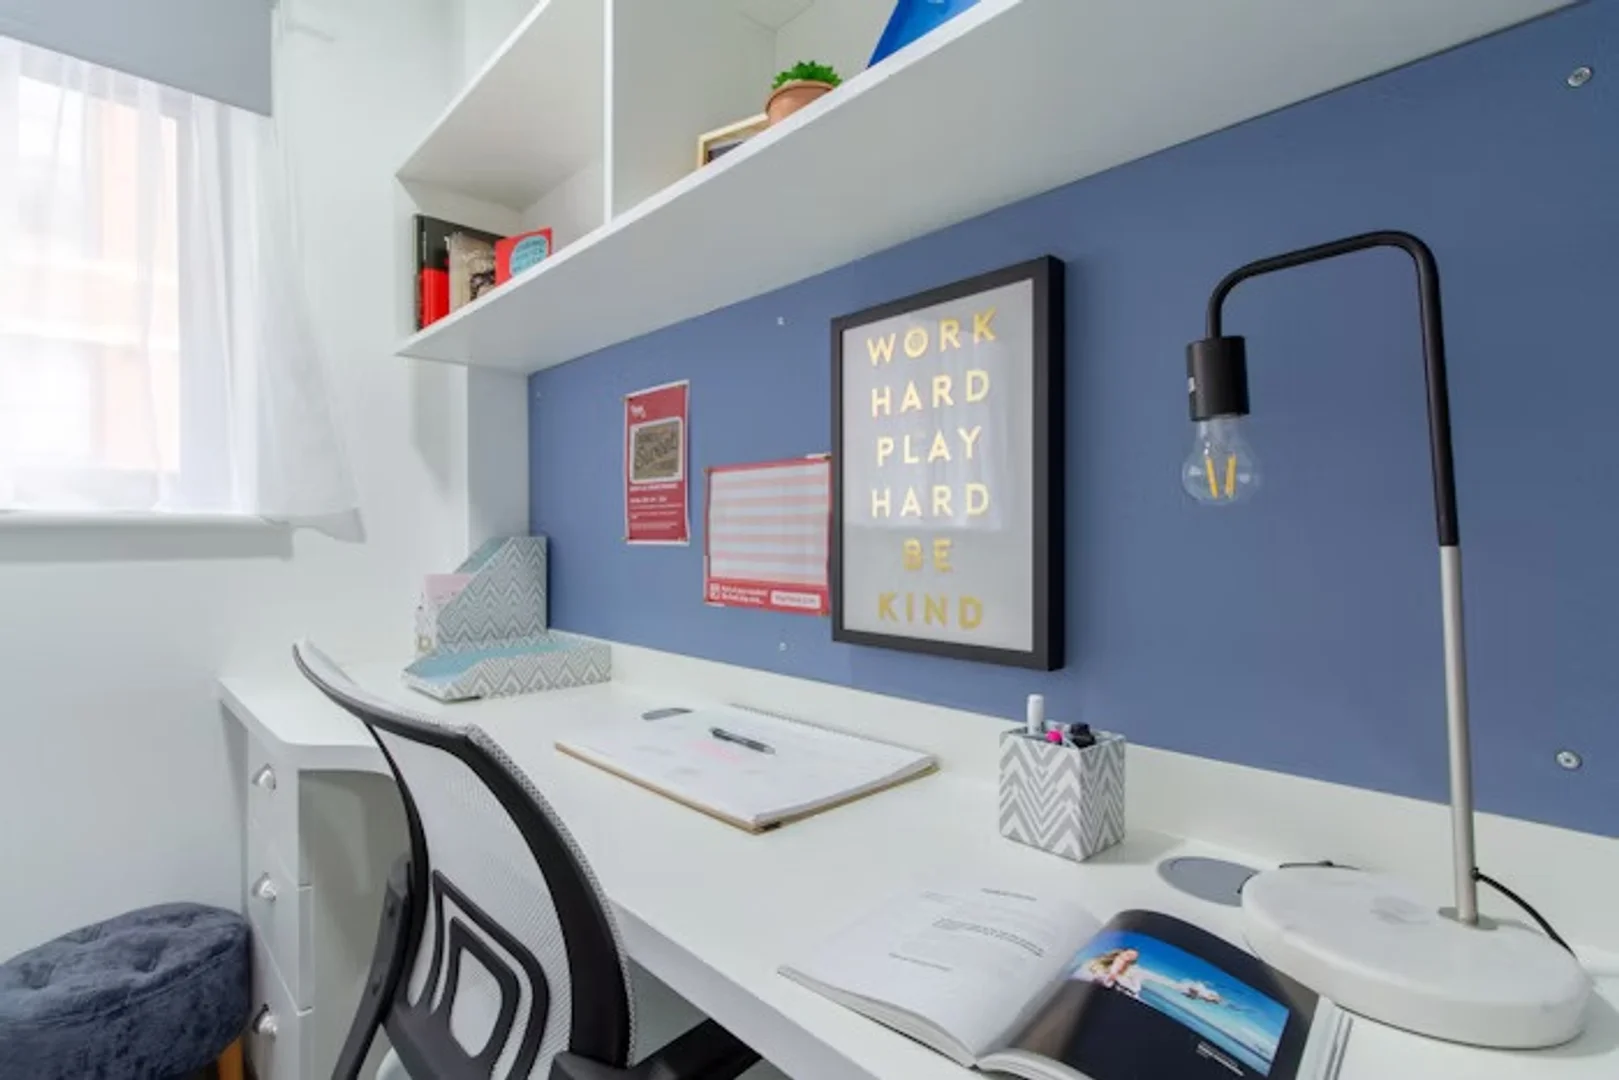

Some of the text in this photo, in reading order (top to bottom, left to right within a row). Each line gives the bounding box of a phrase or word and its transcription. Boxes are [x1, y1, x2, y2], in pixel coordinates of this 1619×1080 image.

[867, 307, 997, 365] WORK
[871, 370, 990, 417] HARD
[876, 426, 982, 467] PLAY
[871, 484, 990, 518] HARD
[902, 538, 954, 573] BE
[878, 591, 984, 630] KIND
